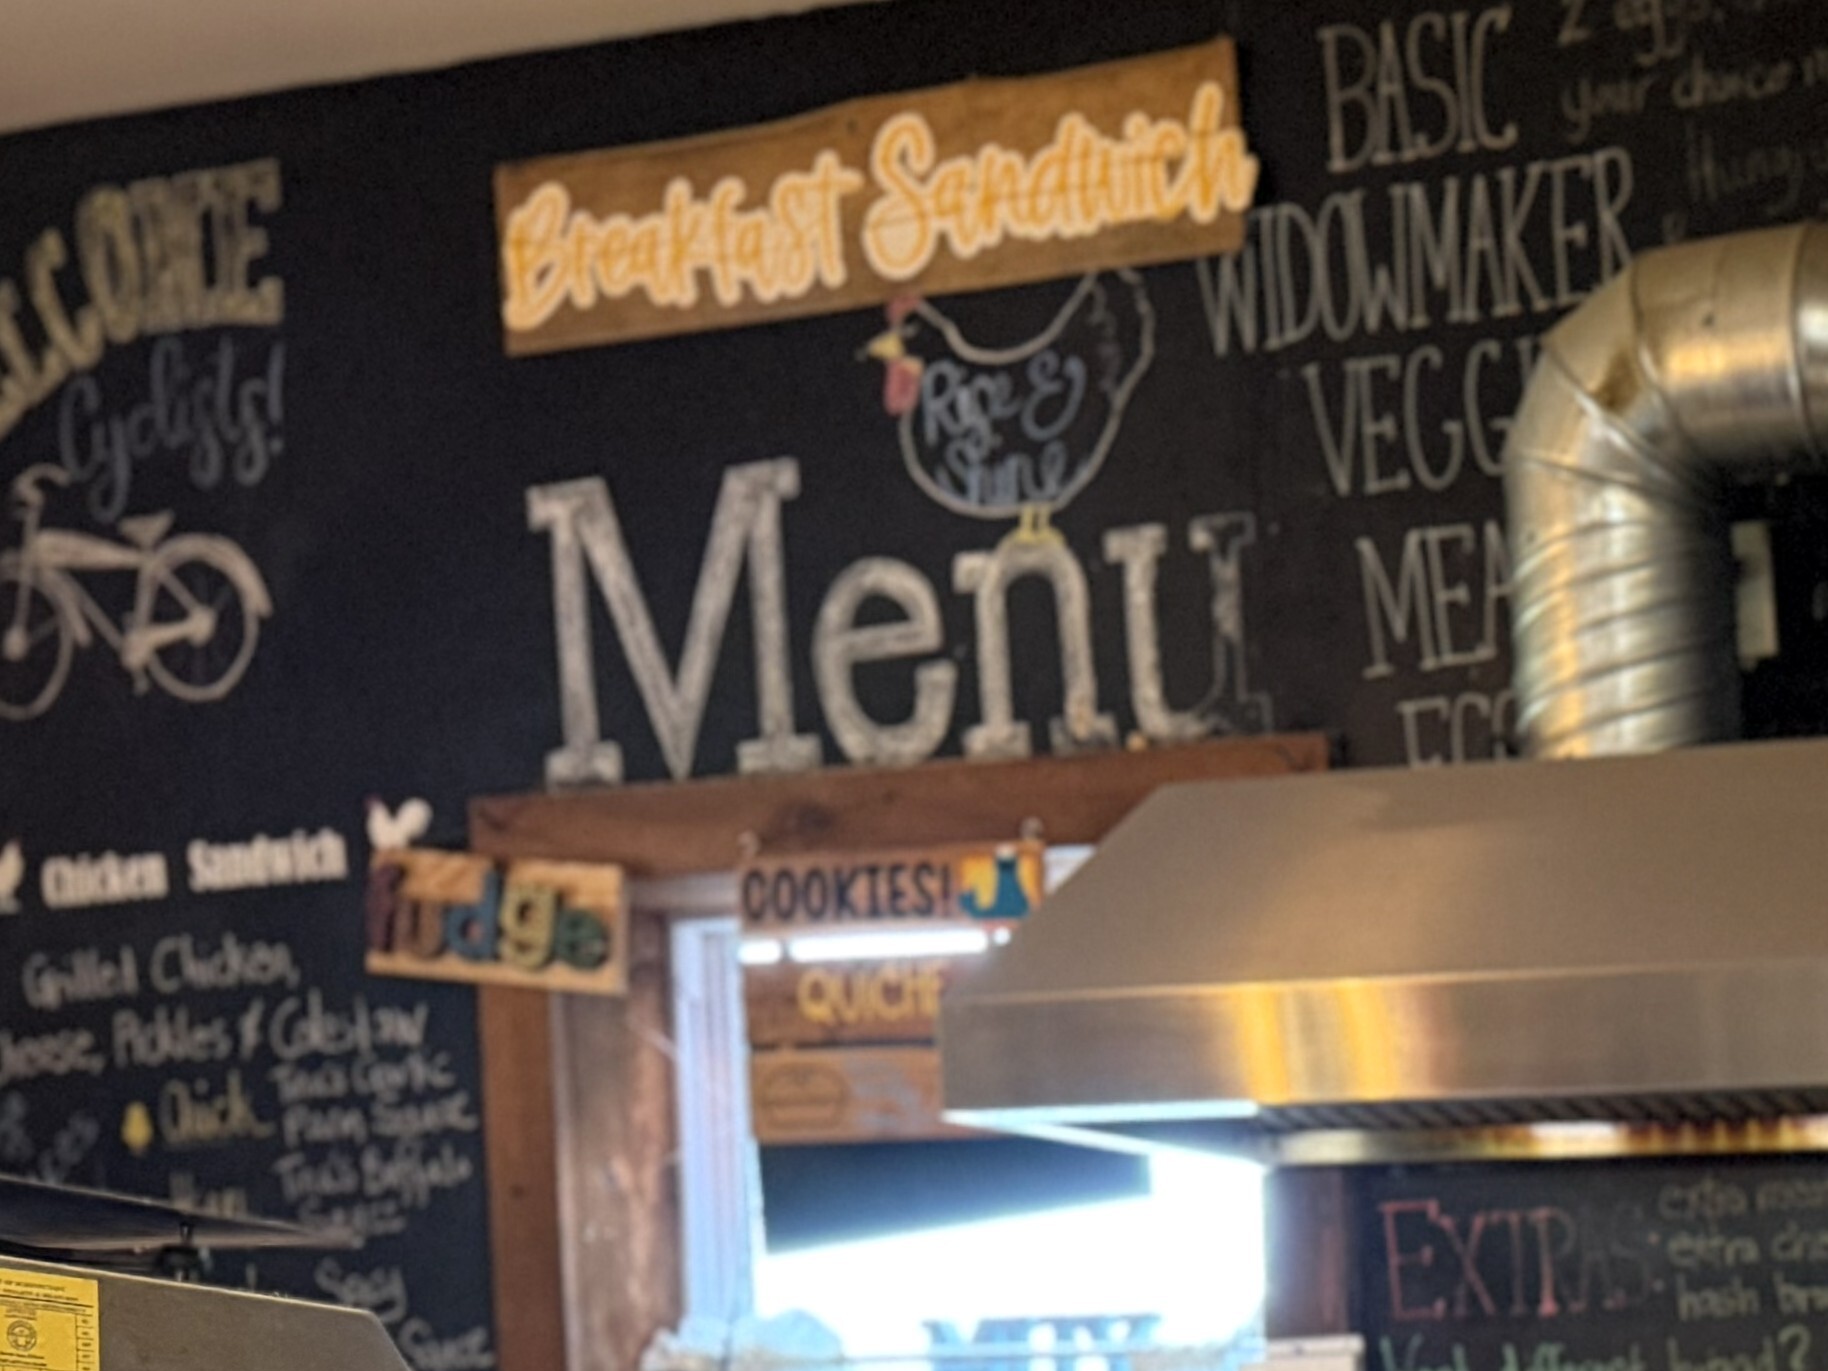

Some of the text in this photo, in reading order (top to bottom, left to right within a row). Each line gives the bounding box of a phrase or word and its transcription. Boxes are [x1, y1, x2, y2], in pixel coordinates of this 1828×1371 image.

[1317, 7, 1519, 173] BASIC
[502, 80, 1261, 331] Breakfast Sandwich
[526, 457, 1272, 785] Menu
[741, 858, 951, 922] COOKIES!
